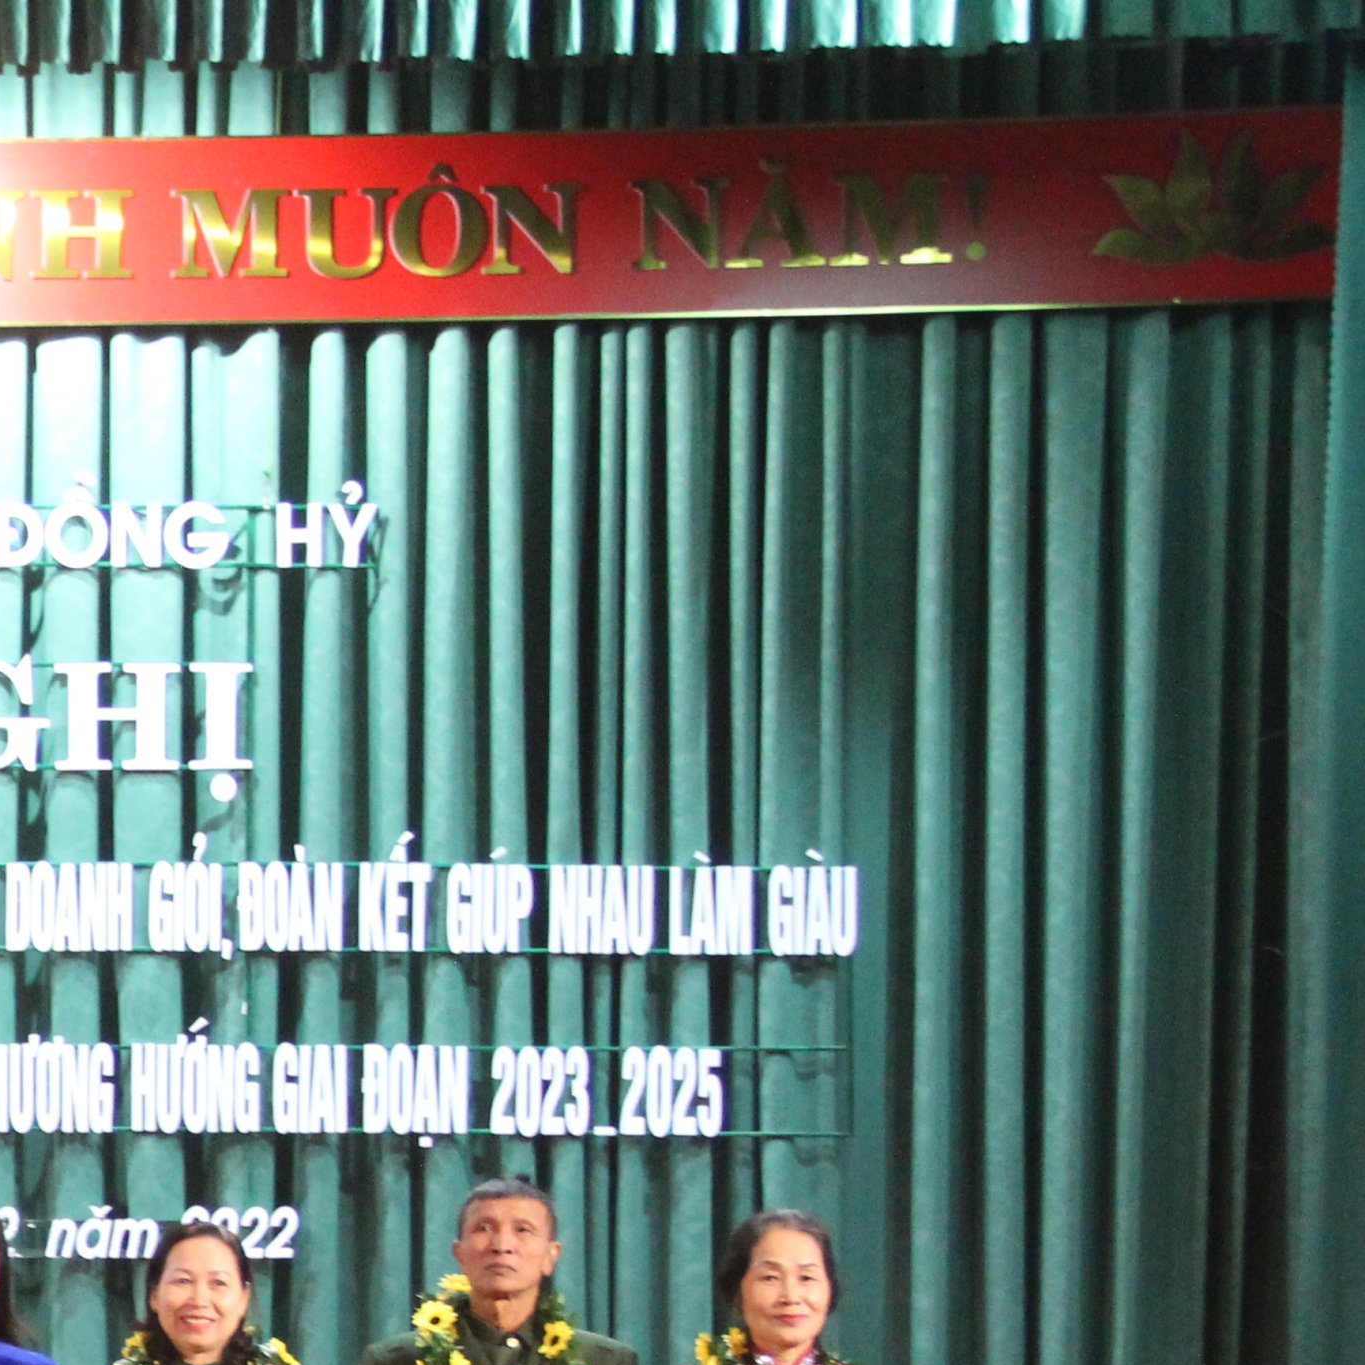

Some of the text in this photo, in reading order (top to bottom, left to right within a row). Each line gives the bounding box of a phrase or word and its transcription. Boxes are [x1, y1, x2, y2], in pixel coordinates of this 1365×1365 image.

[171, 163, 581, 278] MUÔN
[275, 480, 379, 569] HỶ
[5, 861, 133, 952] DOANH
[148, 832, 233, 960] GIỎI,
[237, 844, 344, 952] ĐOÀN
[358, 830, 432, 952] KẾT
[446, 846, 534, 954] GIÚP
[548, 864, 655, 955] NHAU
[670, 850, 753, 955] LÀM
[767, 848, 858, 956] GIÀU
[130, 1016, 261, 1134] HƯỚNG
[273, 1042, 349, 1135] GIAI
[361, 1043, 469, 1148] ĐOẠN
[45, 1205, 160, 1259] năm
